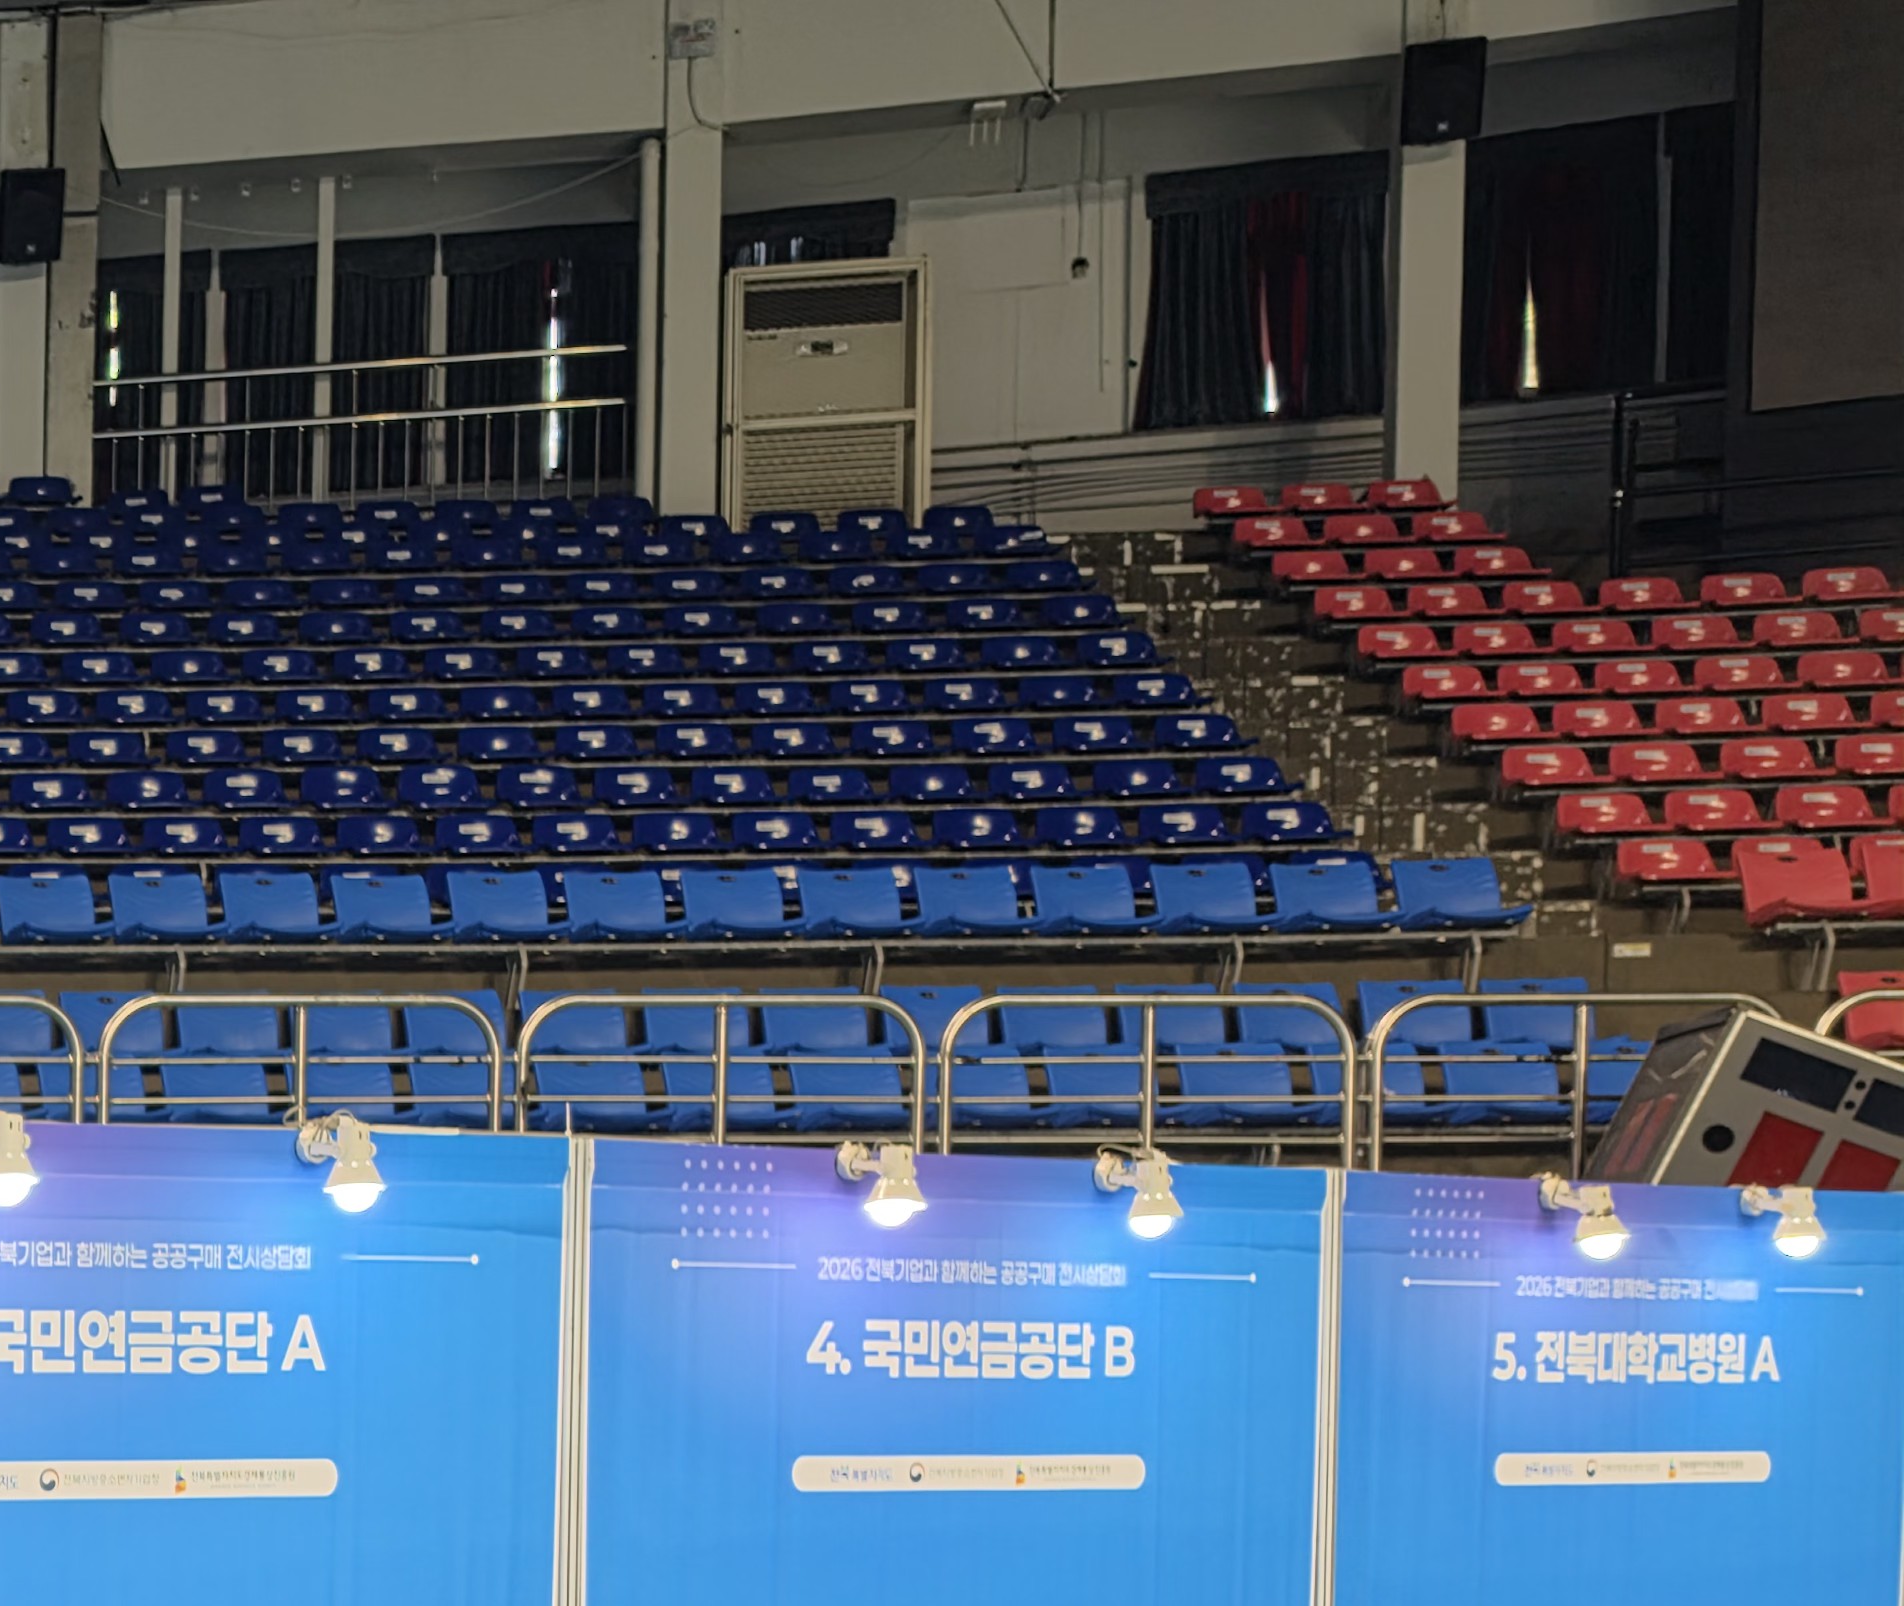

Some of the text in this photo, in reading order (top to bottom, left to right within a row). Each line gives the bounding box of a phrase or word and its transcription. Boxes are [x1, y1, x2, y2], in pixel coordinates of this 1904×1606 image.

[76, 1241, 148, 1269] 함께하는
[152, 1243, 222, 1270] 공공구매
[226, 1243, 312, 1271] 전시상담회
[817, 1256, 863, 1282] 2026
[865, 1257, 938, 1284] 전북기업과
[941, 1259, 997, 1285] 함께하는
[1515, 1275, 1552, 1297] 2026
[281, 1314, 327, 1371] A
[806, 1318, 1136, 1379] 4. 국민연금공단 B
[1492, 1331, 1781, 1384] 5. 전북대학교병원 A
